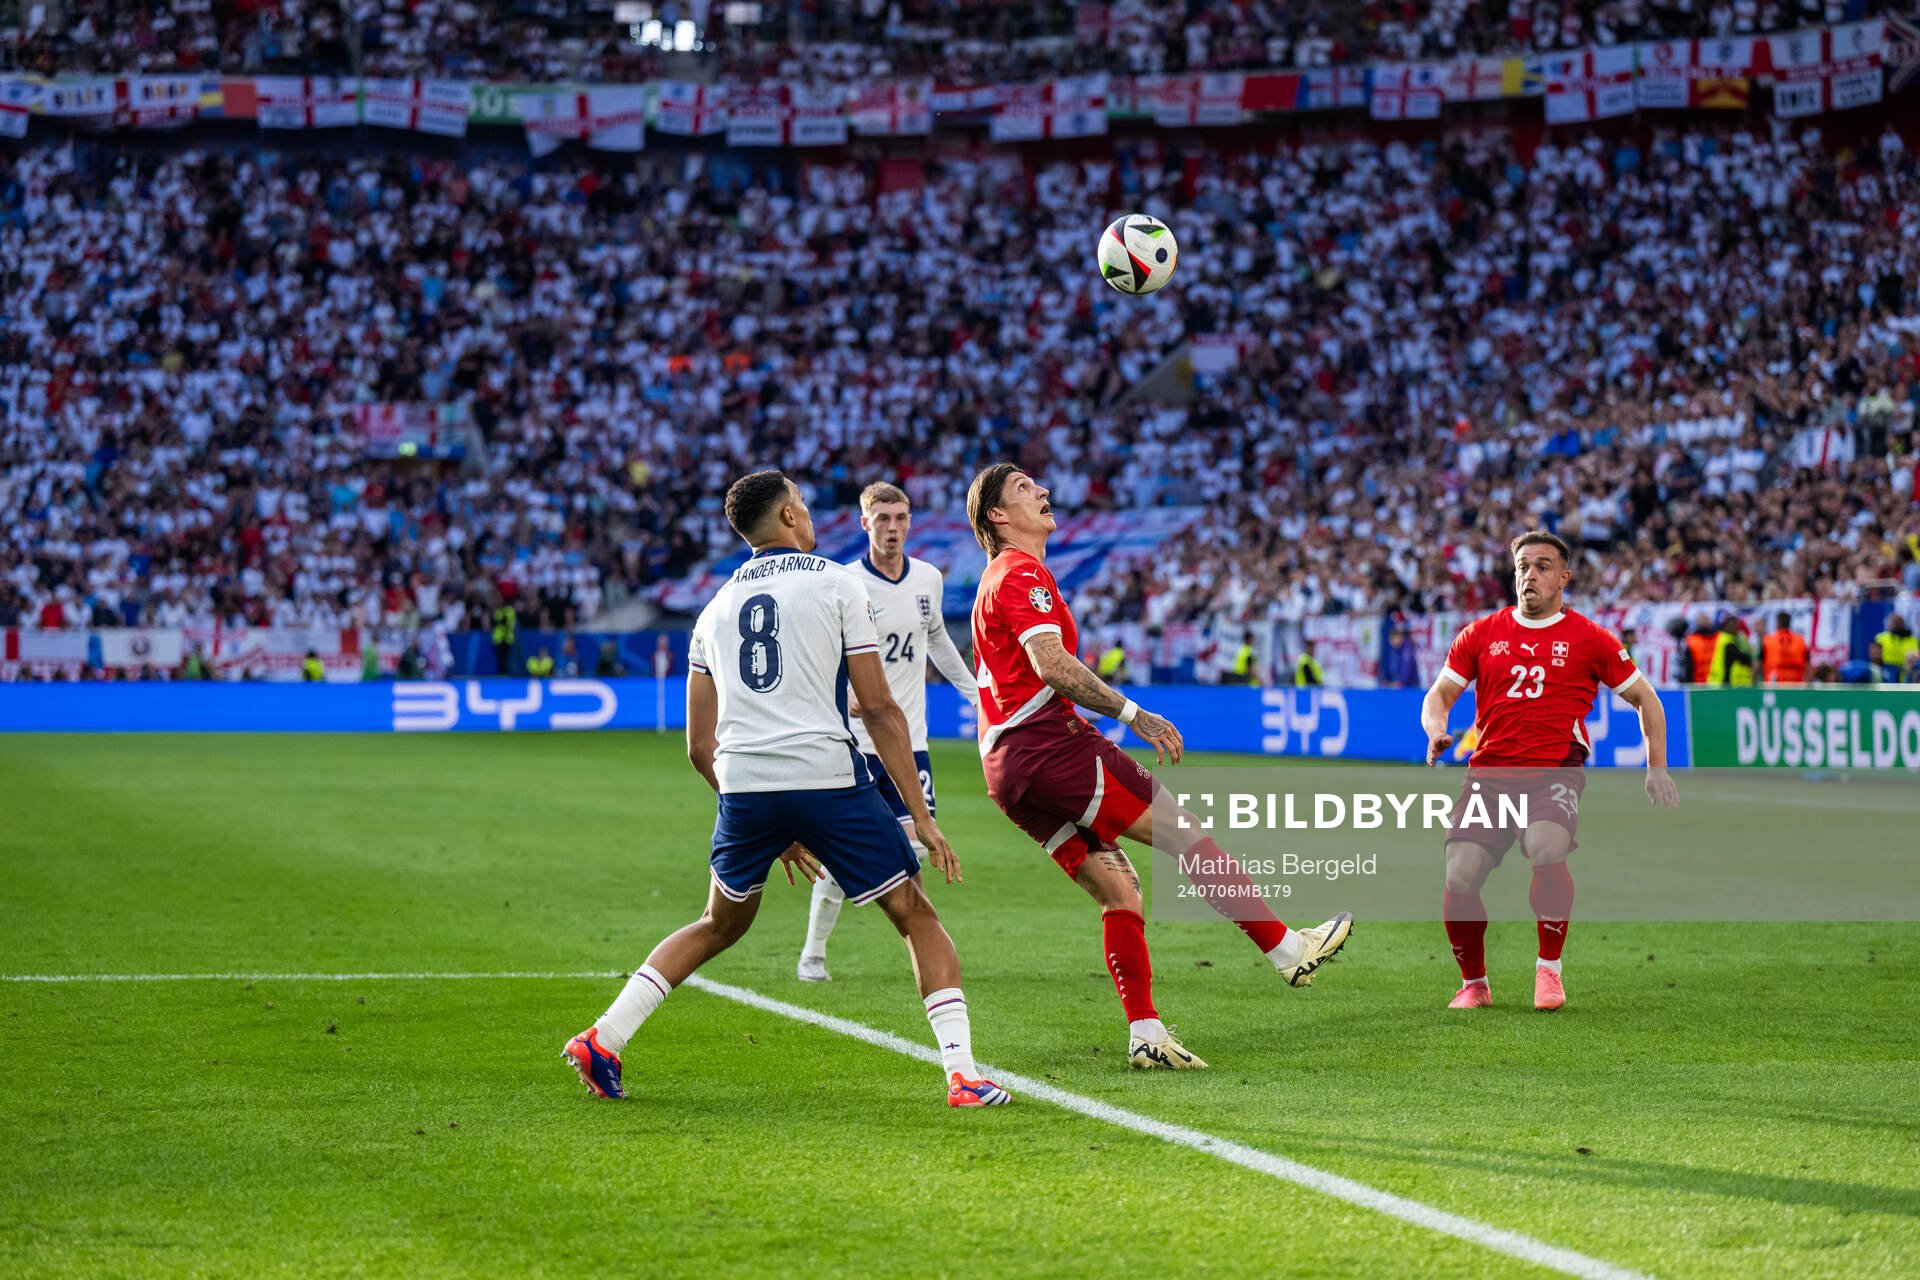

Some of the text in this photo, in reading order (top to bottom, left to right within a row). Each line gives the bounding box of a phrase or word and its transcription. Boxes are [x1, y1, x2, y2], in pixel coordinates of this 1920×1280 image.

[738, 593, 783, 693] 8
[885, 632, 914, 663] 24
[393, 679, 618, 732] BYD
[1506, 665, 1546, 699] 23
[1262, 688, 1349, 756] BYD
[1736, 691, 1920, 771] DÜSSELDO
[1551, 783, 1579, 815] 23
